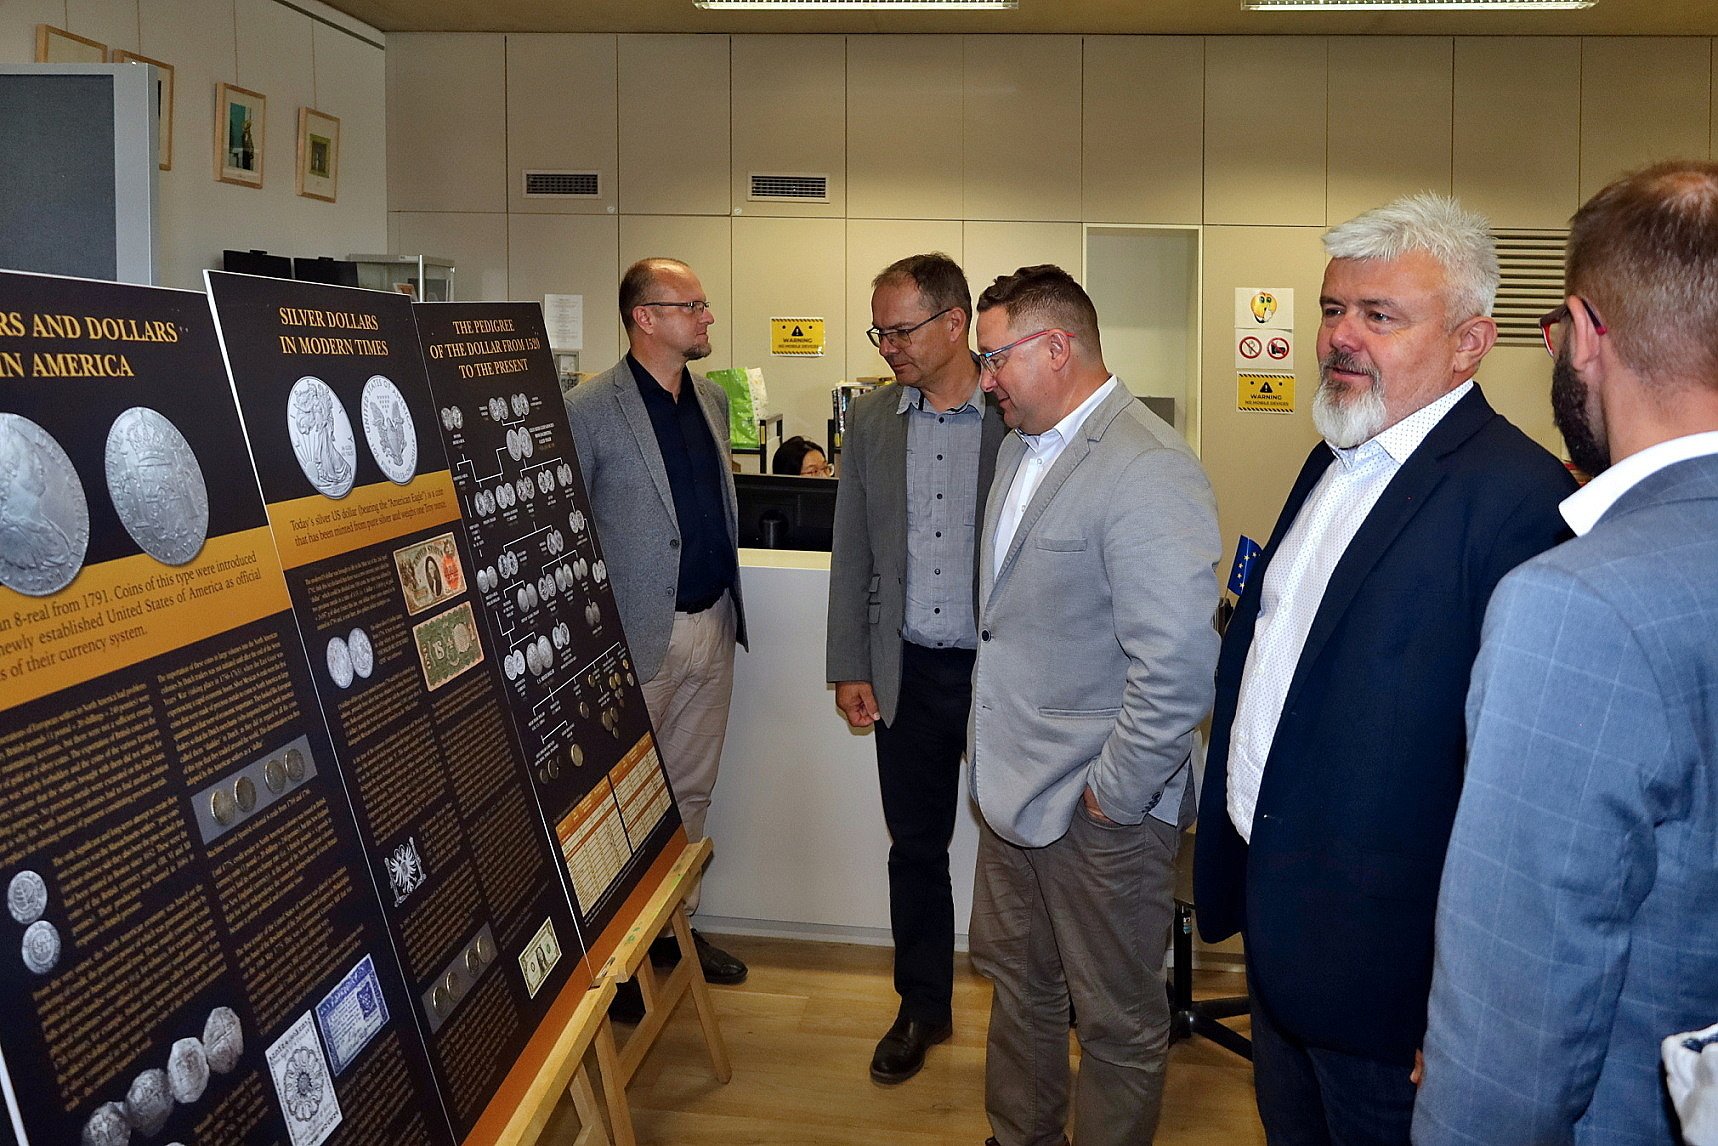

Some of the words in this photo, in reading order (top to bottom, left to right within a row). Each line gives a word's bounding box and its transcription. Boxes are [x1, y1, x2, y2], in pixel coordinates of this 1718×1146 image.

[33, 313, 81, 339] AND
[84, 316, 178, 343] DOLLARS
[280, 307, 326, 327] SILVER
[326, 311, 379, 331] DOLLARS
[453, 320, 474, 335] THE
[474, 319, 515, 334] PEDIGREE
[279, 335, 297, 354] IN
[298, 336, 354, 355] MODERN
[355, 339, 389, 356] TIMES
[429, 344, 443, 359] OF
[445, 342, 467, 358] THE
[466, 340, 503, 356] DOLLAR
[502, 338, 525, 353] FROM
[33, 352, 135, 378] AMERICA
[459, 364, 474, 379] TO
[474, 362, 494, 377] THE
[493, 358, 528, 375] PRESENT
[331, 509, 341, 521] US
[14, 603, 50, 628] 8-real
[51, 599, 81, 617] from
[82, 589, 114, 609] 1791.
[114, 582, 143, 600] Coins
[144, 575, 156, 592] of
[156, 573, 174, 589] this
[175, 569, 195, 587] type
[195, 565, 216, 578] were
[216, 550, 257, 573] introduced
[38, 612, 105, 645] established
[106, 600, 143, 624] United
[144, 594, 175, 613] States
[176, 587, 187, 603] of
[188, 582, 224, 600] America
[225, 579, 235, 589] as
[235, 567, 262, 584] official
[10, 658, 24, 678] of
[26, 651, 57, 673] their
[58, 636, 107, 663] currency
[108, 625, 148, 649] system.
